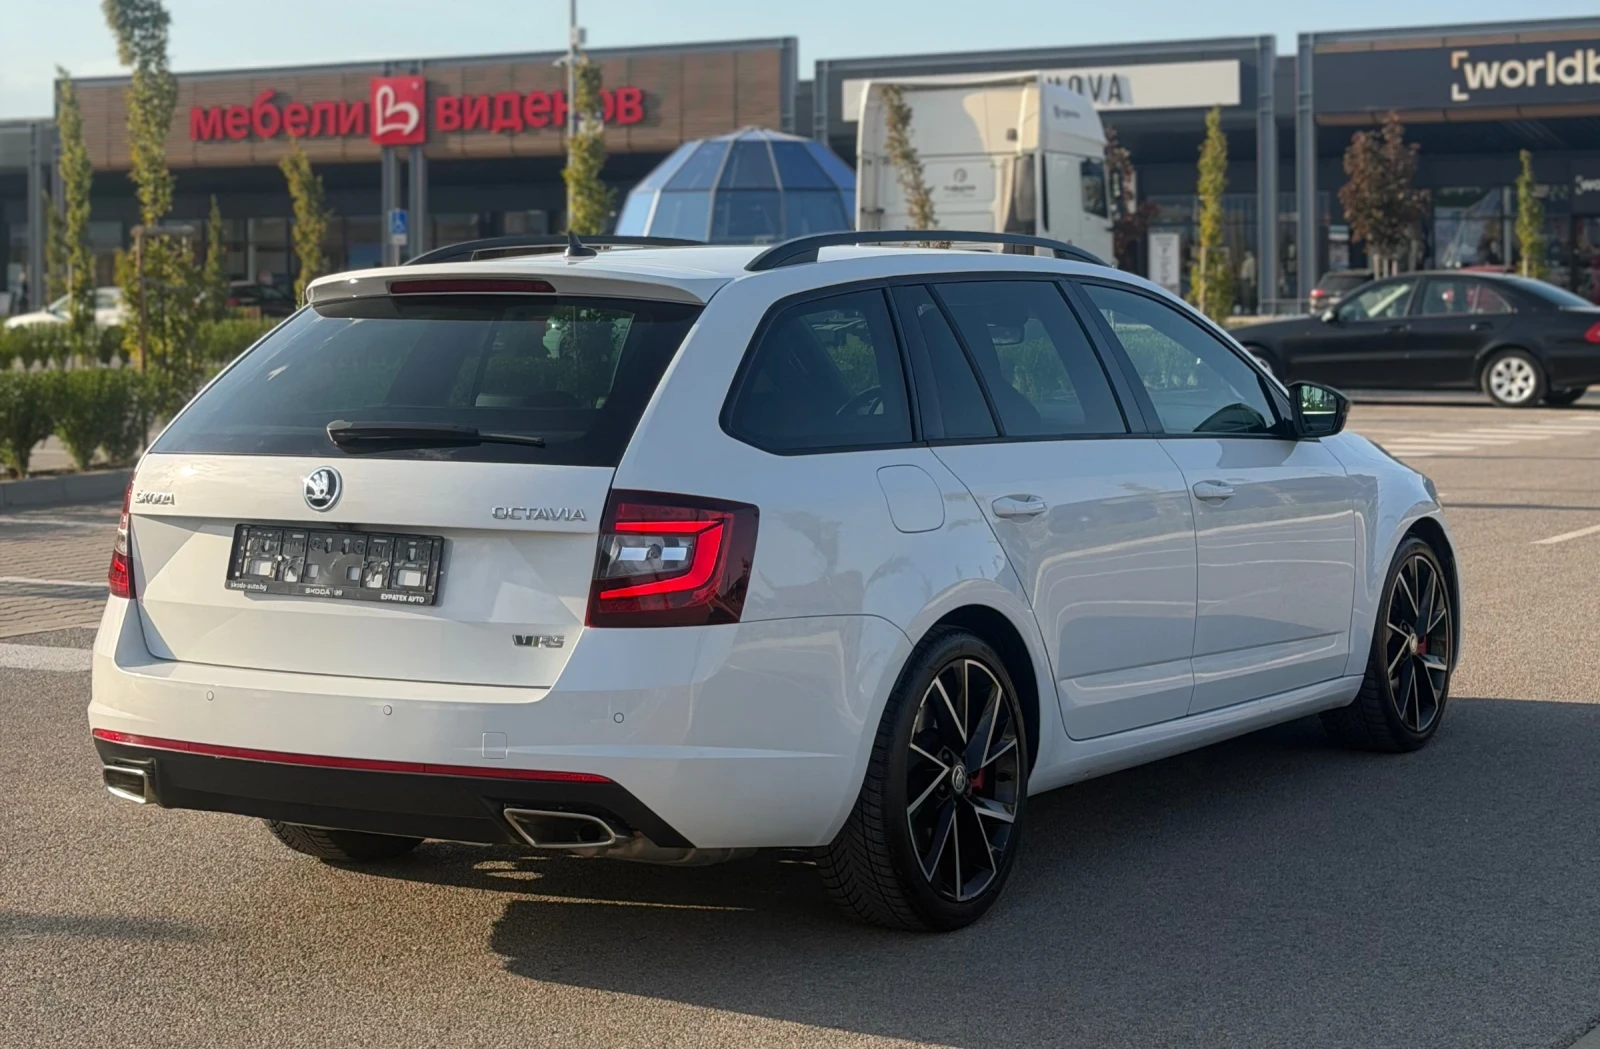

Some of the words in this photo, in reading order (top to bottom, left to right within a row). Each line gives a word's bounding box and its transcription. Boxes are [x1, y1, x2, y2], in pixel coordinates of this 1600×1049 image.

[190, 88, 366, 141] мебели
[491, 506, 587, 521] OCTAVIA
[230, 582, 268, 592] skoda-auto.bg
